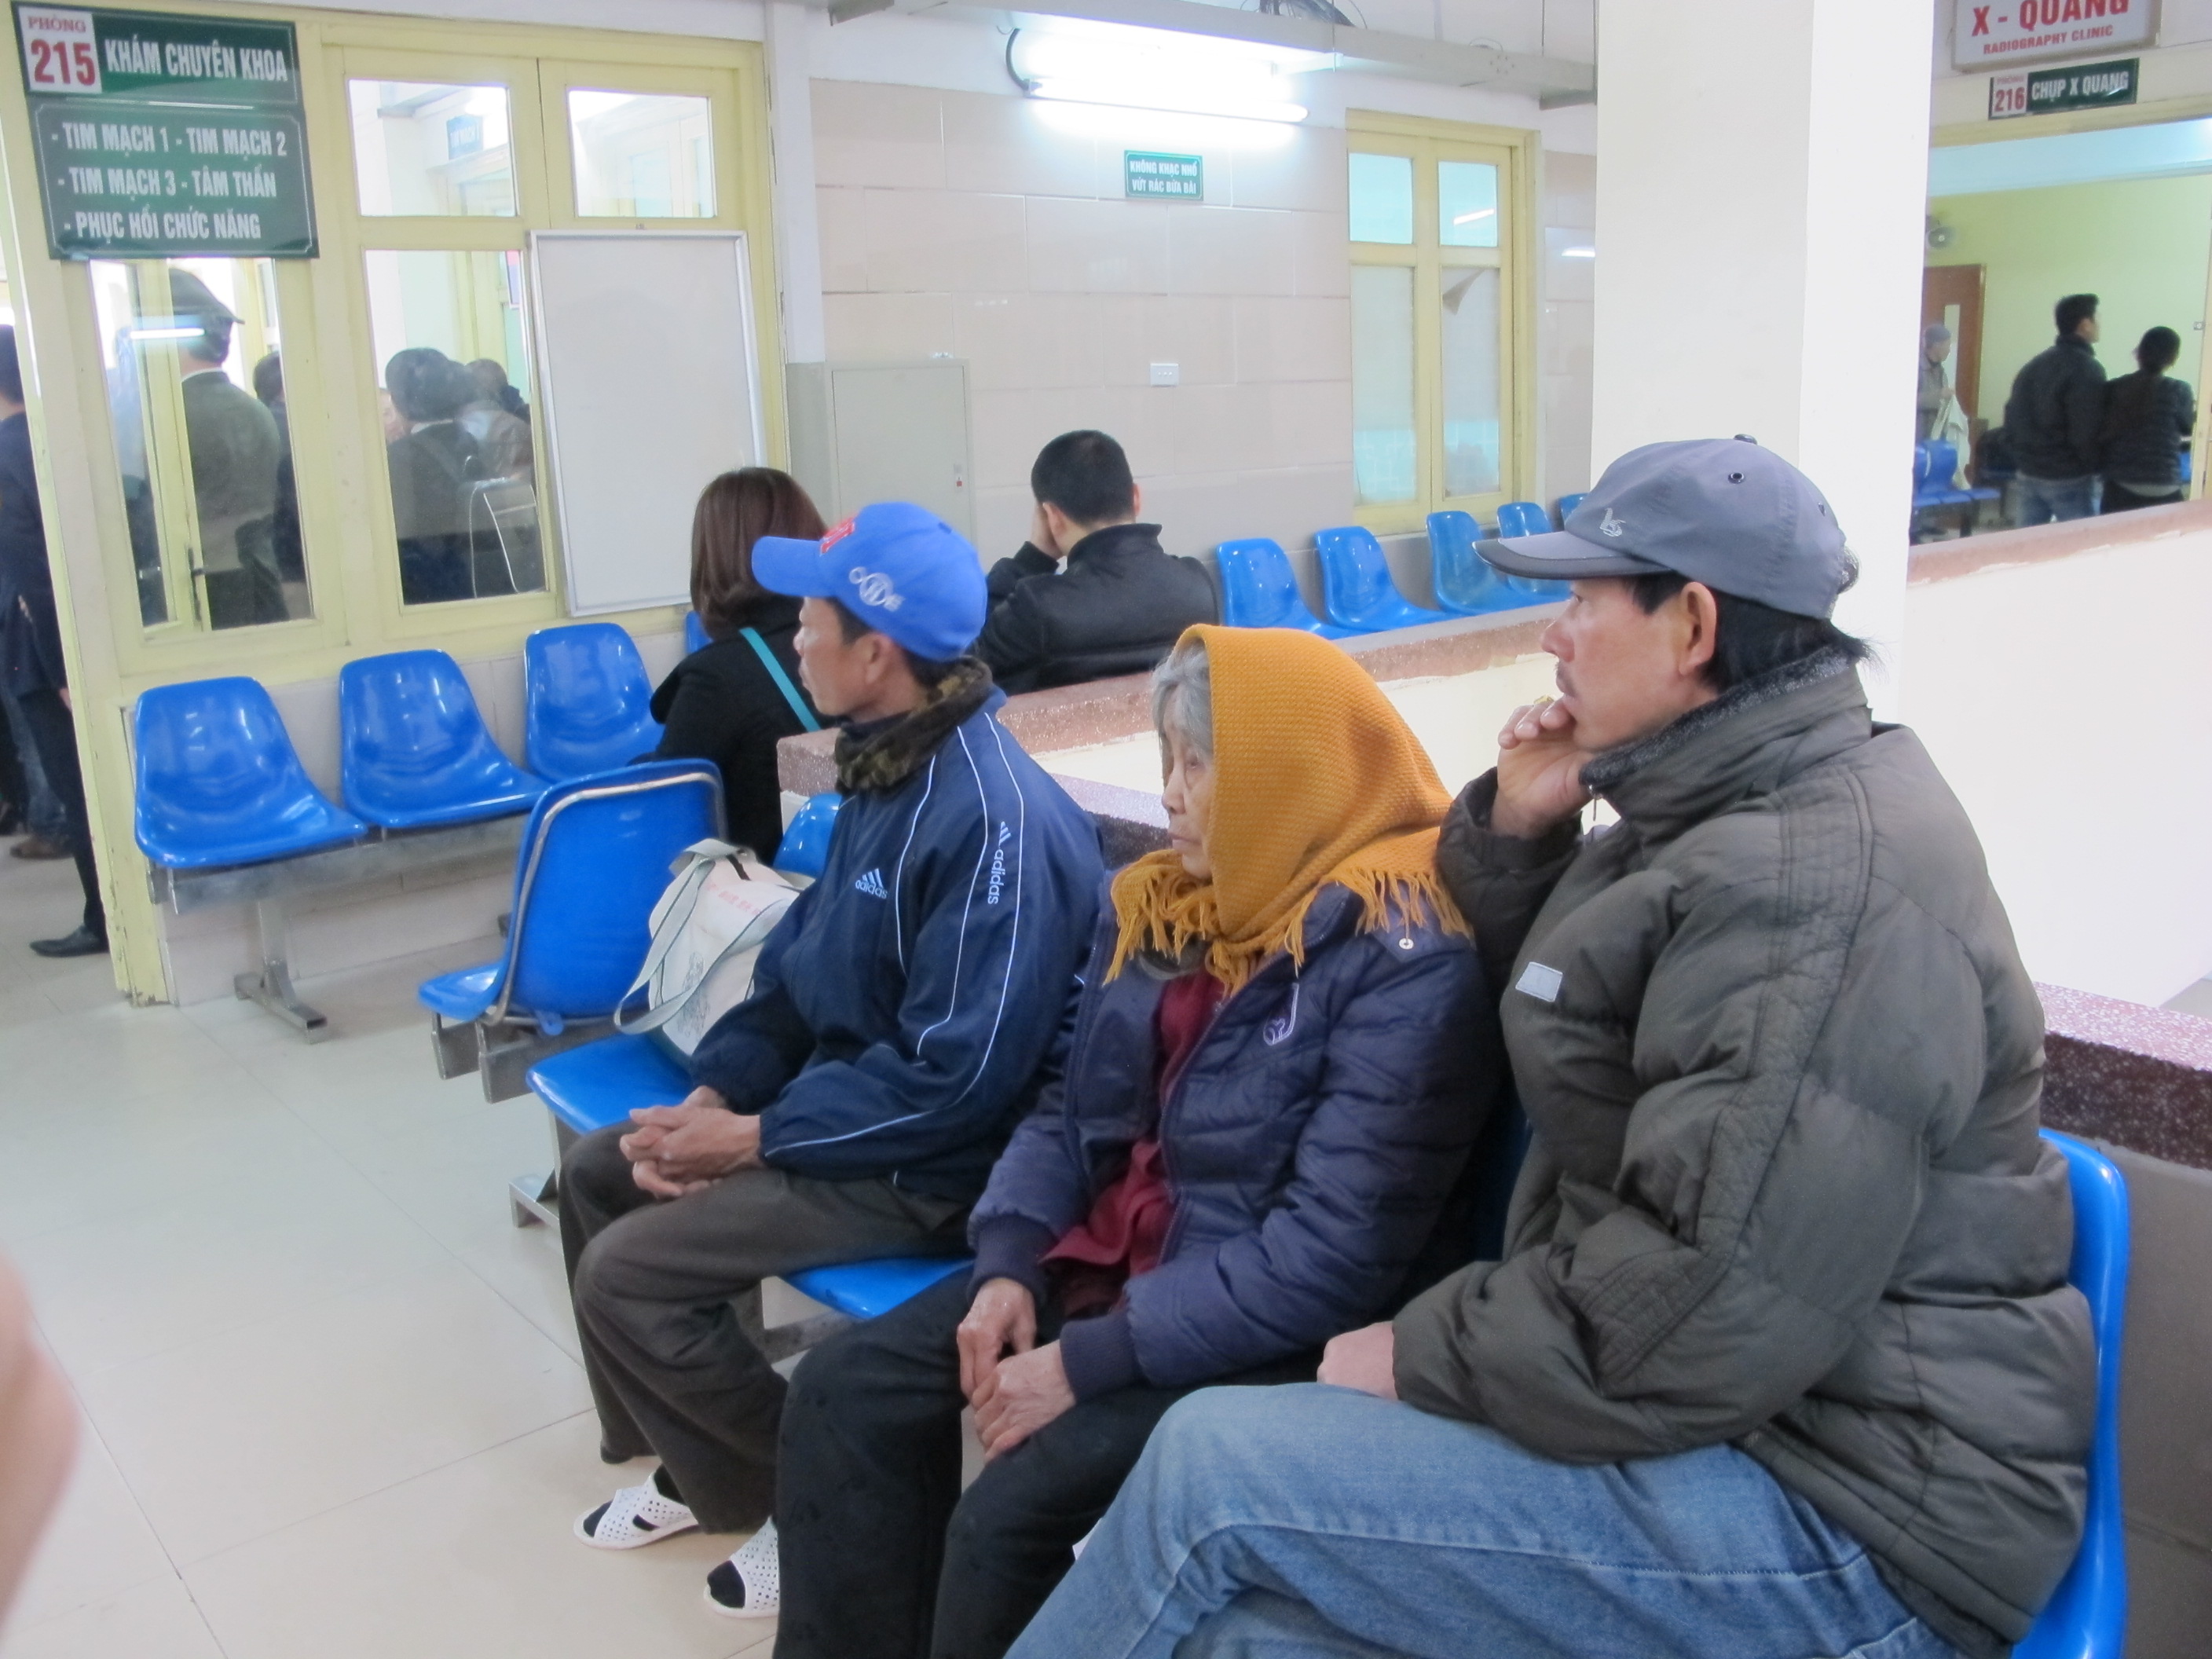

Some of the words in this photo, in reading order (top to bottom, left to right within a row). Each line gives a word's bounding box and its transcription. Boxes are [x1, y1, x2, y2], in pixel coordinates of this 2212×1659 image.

[27, 14, 86, 32] PHÒNG
[1972, 5, 1990, 36] X
[1983, 32, 2067, 54] RADIOGRAPHY
[2071, 24, 2113, 42] CLINIC
[31, 38, 95, 86] 215
[104, 34, 162, 75] KHÁM
[165, 39, 236, 78] CHUYÊN
[239, 48, 288, 82] KHOA
[1994, 87, 2025, 112] 216
[2031, 79, 2066, 102] CHỤP
[2069, 77, 2080, 97] X
[2082, 71, 2130, 96] QUANG
[63, 122, 97, 151] TIM
[101, 124, 156, 157] MẠCH
[159, 126, 170, 152] 1
[186, 127, 219, 154] TIM
[222, 128, 273, 161] MẠCH
[275, 130, 287, 156] 2
[68, 167, 104, 195] TIM
[107, 167, 161, 201] MẠCH
[165, 169, 177, 196] 3
[191, 165, 229, 196] TÂM
[1130, 159, 1157, 174] KHÔNG
[1159, 163, 1180, 178] KHẠC
[1132, 177, 1147, 192] VỨT
[1148, 178, 1165, 193] RÁC
[75, 211, 124, 244] PHỤC
[163, 205, 210, 239] CHỨC
[213, 208, 262, 239] NĂNG
[855, 879, 888, 899] adidas
[987, 848, 1006, 905] adidas
